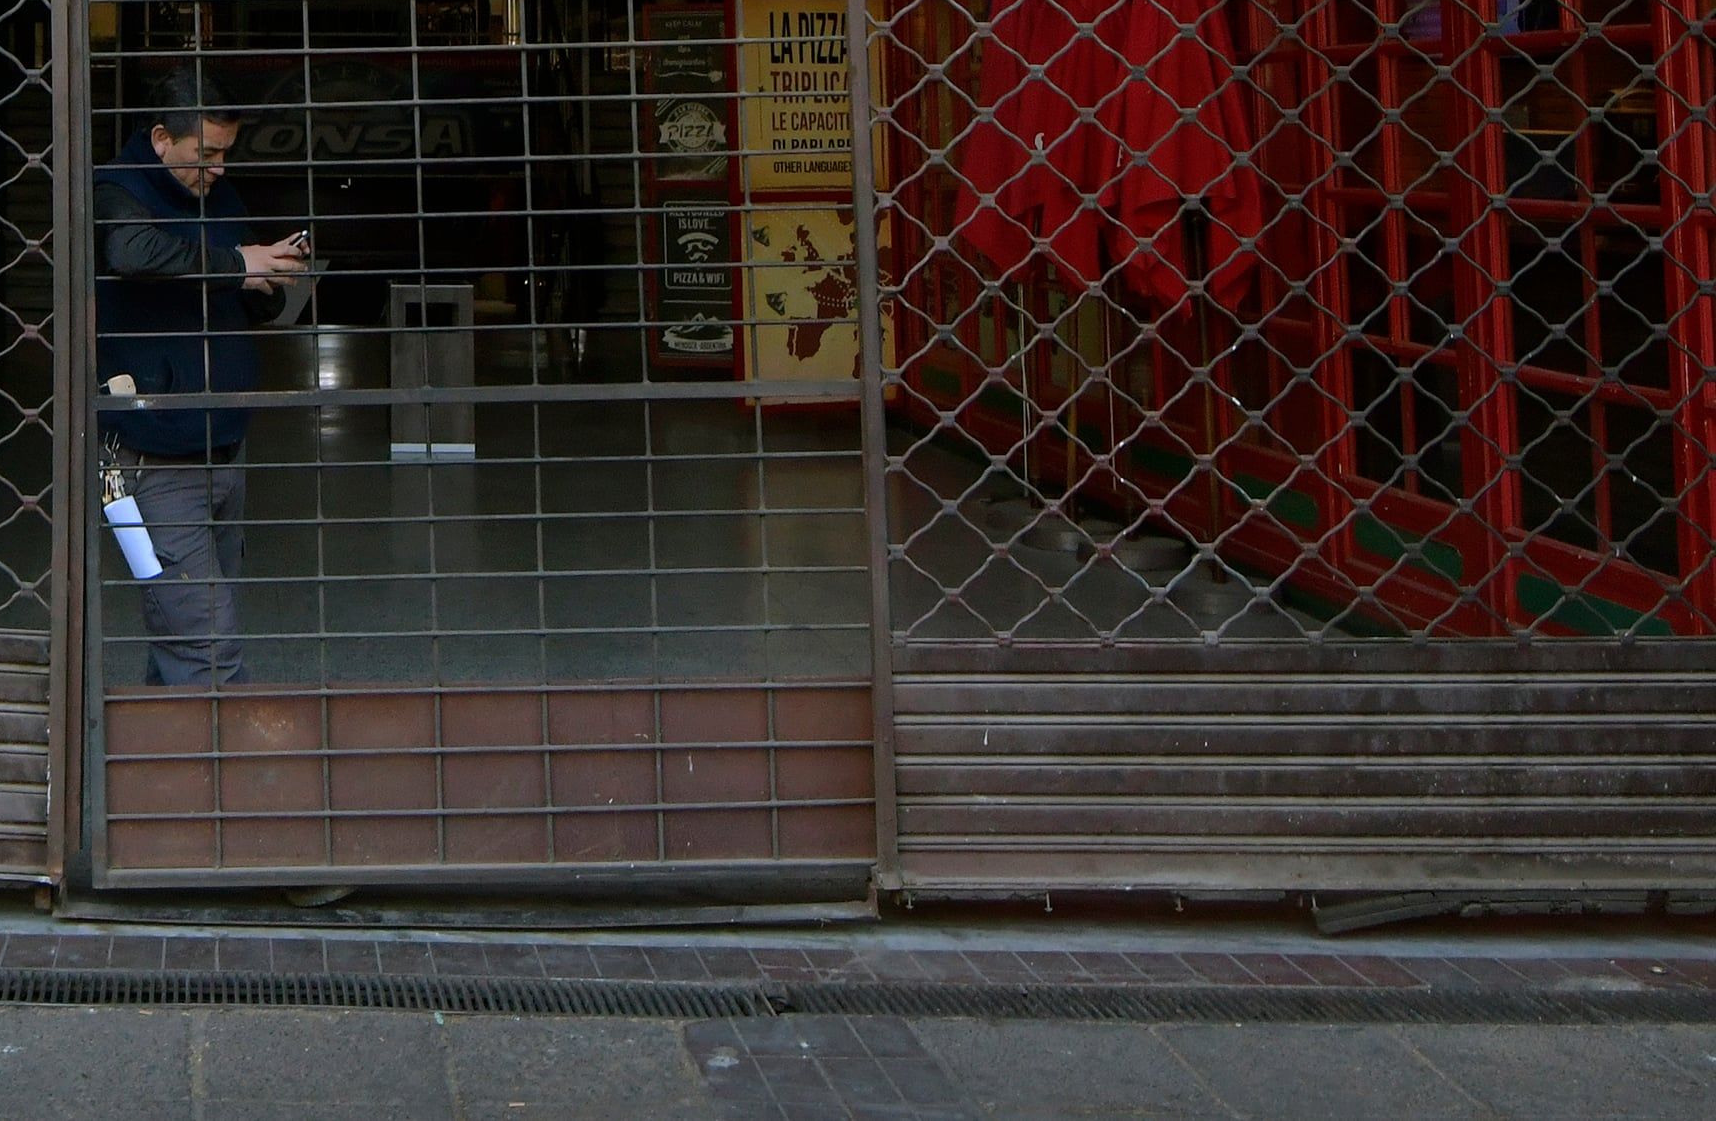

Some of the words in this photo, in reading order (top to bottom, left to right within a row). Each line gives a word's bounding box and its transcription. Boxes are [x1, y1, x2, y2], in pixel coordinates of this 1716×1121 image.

[770, 12, 793, 63] LA
[798, 12, 848, 63] PIZZA
[772, 112, 787, 131] LE
[241, 117, 464, 155] ONSA
[773, 162, 802, 173] OTHER
